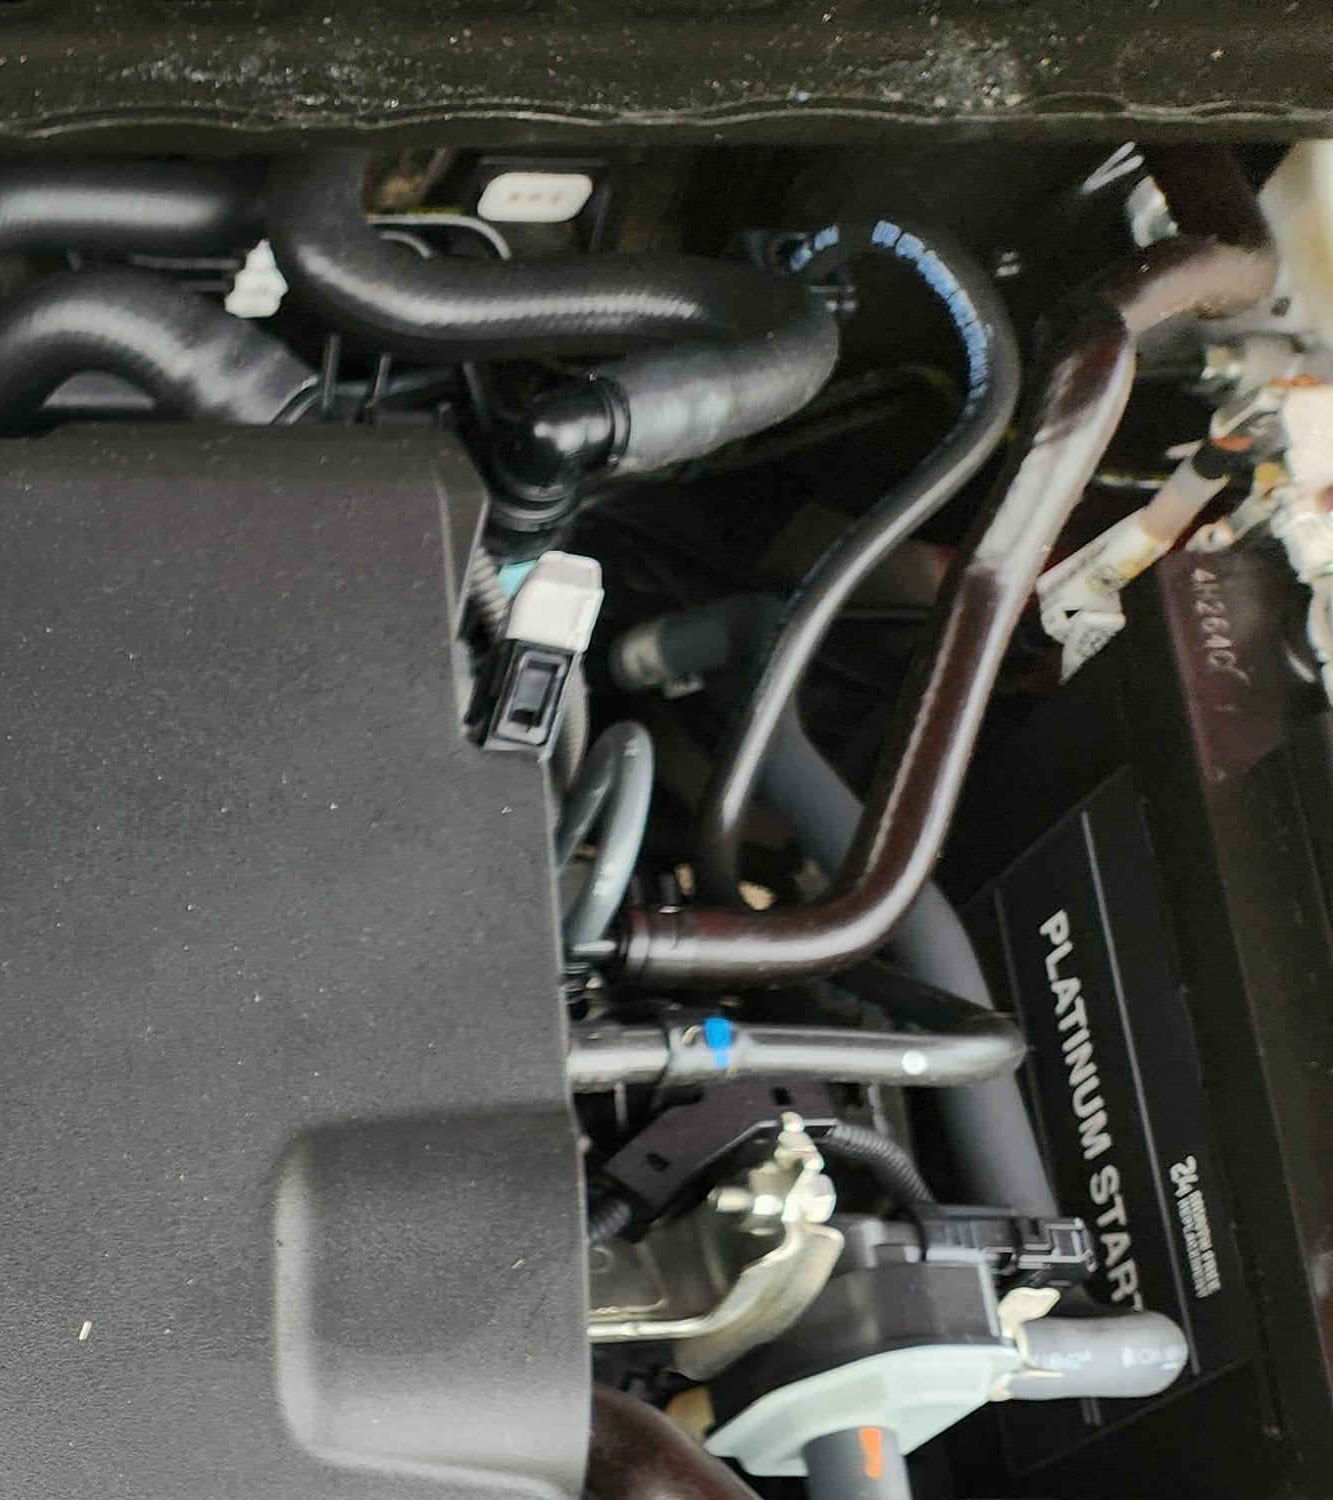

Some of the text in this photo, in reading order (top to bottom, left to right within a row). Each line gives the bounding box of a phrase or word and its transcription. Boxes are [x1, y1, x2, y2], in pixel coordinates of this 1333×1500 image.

[1039, 909, 1144, 1312] PLATINUM STAR
[1169, 1155, 1200, 1198] 24
